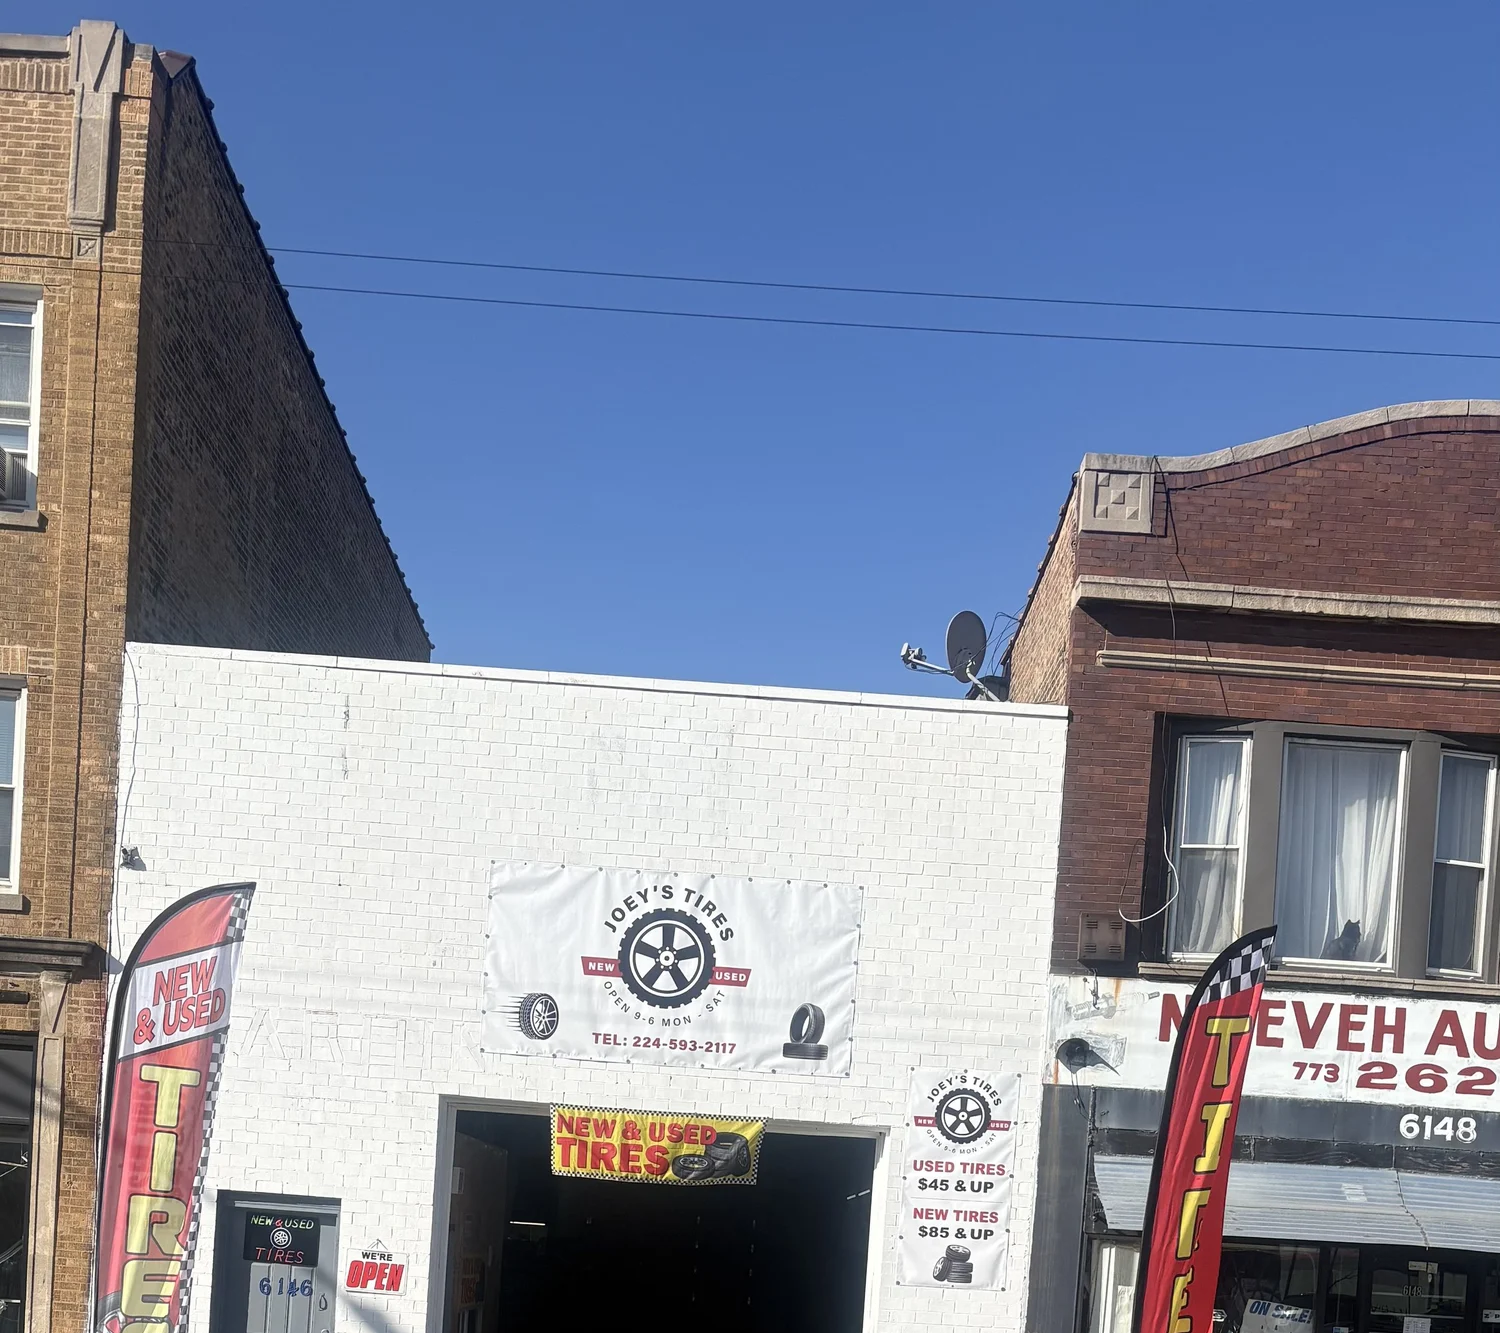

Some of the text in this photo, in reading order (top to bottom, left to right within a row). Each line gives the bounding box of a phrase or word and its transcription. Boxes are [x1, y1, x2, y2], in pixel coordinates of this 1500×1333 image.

[604, 885, 734, 942] JOEY'S TIRES
[588, 961, 615, 973] NEW
[715, 971, 747, 983] USED
[152, 955, 218, 1007] NEW
[603, 980, 632, 1014] OPEN
[633, 1011, 655, 1027] 9-6
[661, 1016, 693, 1027] MON
[706, 989, 726, 1014] SAT
[133, 987, 227, 1045] & USED
[1159, 993, 1407, 1054] NEVEH
[592, 1032, 737, 1055] TEL: 224-593-2117
[1292, 1061, 1497, 1096] 773 262
[927, 1075, 1002, 1106] JOEY'S TIRES
[557, 1114, 717, 1146] NEW & USED
[926, 1129, 943, 1147] OPEN
[985, 1133, 996, 1146] SAT
[1399, 1113, 1477, 1144] 6148
[557, 1137, 670, 1176] TIRES
[913, 1159, 1006, 1176] USED TIRES
[917, 1178, 994, 1193] $45 & UP
[250, 1214, 314, 1230] NEW & USED
[913, 1207, 999, 1224] NEW TIRES
[918, 1225, 994, 1241] $85 & UP
[255, 1247, 305, 1264] TIRES
[361, 1251, 394, 1262] WE'RE
[346, 1260, 405, 1292] OPEN
[259, 1277, 314, 1297] 6146
[1402, 1285, 1422, 1297] 6148
[1249, 1300, 1271, 1316] ON
